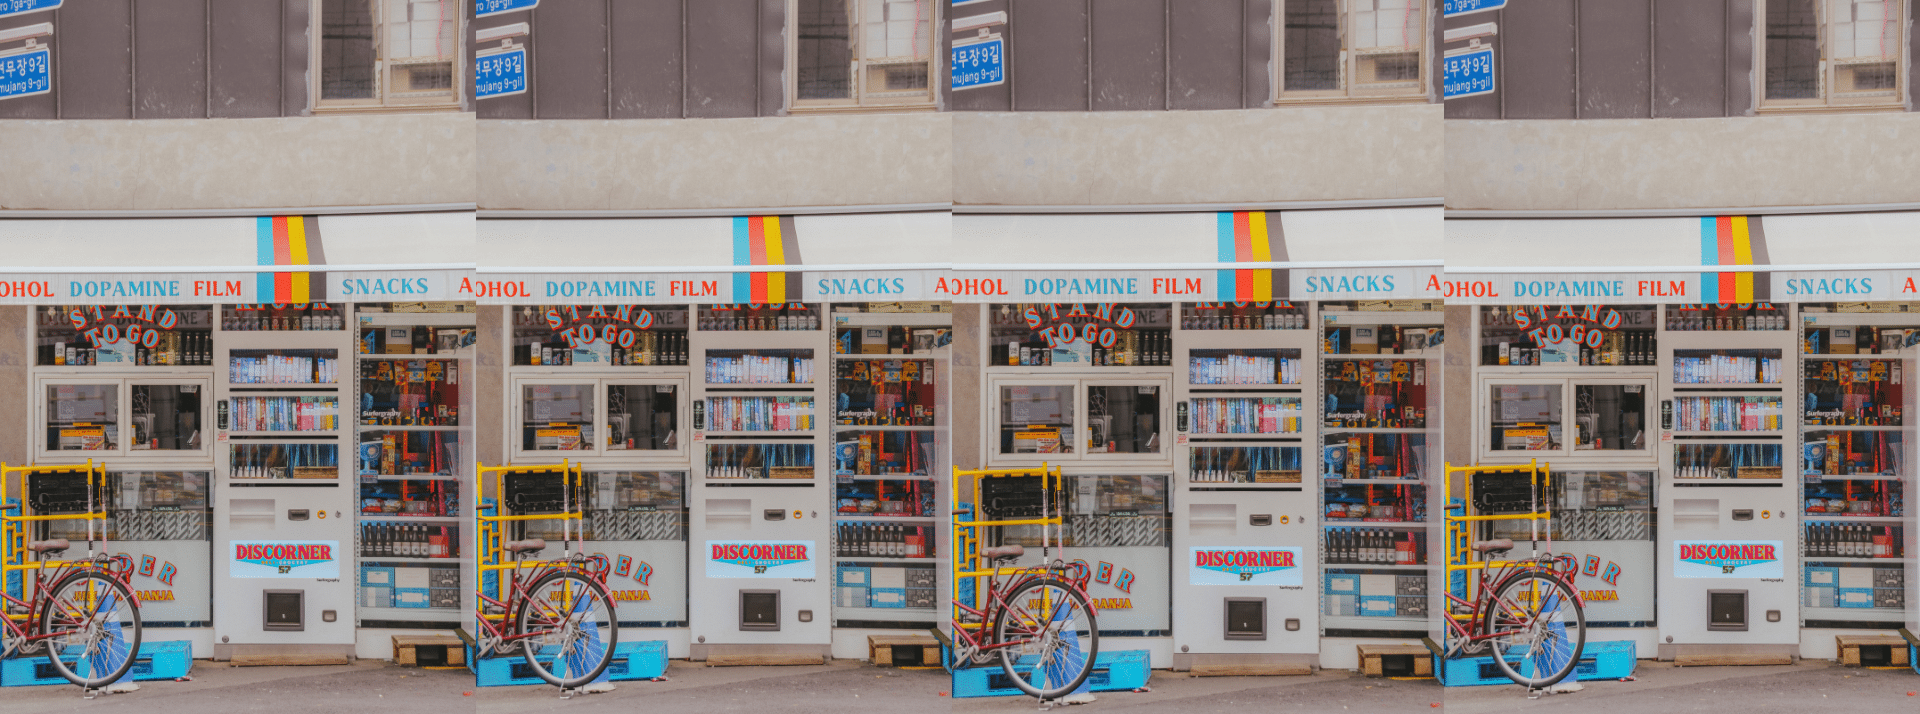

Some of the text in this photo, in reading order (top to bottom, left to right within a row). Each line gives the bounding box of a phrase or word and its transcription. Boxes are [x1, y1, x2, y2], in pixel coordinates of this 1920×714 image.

[28, 76, 46, 90] 9-gil
[504, 76, 522, 90] 9-gil
[980, 66, 1000, 81] 9-gil
[1472, 76, 1490, 90] 9-gil
[0, 280, 54, 297] OHOL
[70, 280, 180, 297] DOPAMINE
[194, 280, 242, 297] FILM
[342, 277, 428, 295] SNACKS
[476, 280, 530, 297] OHOL
[546, 280, 656, 297] DOPAMINE
[670, 280, 718, 297] FILM
[818, 277, 904, 295] SNACKS
[952, 278, 1008, 295] OHOL
[1024, 278, 1138, 295] DOPAMINE
[1153, 278, 1202, 295] FILM
[1306, 274, 1395, 293] SNACKS
[1444, 280, 1498, 297] OHOL
[1514, 280, 1624, 297] DOPAMINE
[1638, 280, 1686, 297] FILM
[1786, 277, 1872, 295] SNACKS
[69, 304, 178, 330] STAND
[545, 304, 654, 330] STAND
[1023, 303, 1136, 330] STAND
[1513, 304, 1622, 330] STAND
[84, 323, 160, 350] TO GO
[560, 323, 636, 350] TO GO
[1039, 322, 1117, 350] TO GO
[1528, 323, 1604, 350] TO GO
[236, 543, 333, 560] DISCORNER
[712, 543, 809, 560] DISCORNER
[1195, 549, 1296, 567] DISCORNER
[1680, 543, 1777, 560] DISCORNER
[278, 565, 291, 574] 57
[754, 565, 767, 574] 57
[1239, 572, 1253, 581] 57
[1722, 565, 1735, 574] 57
